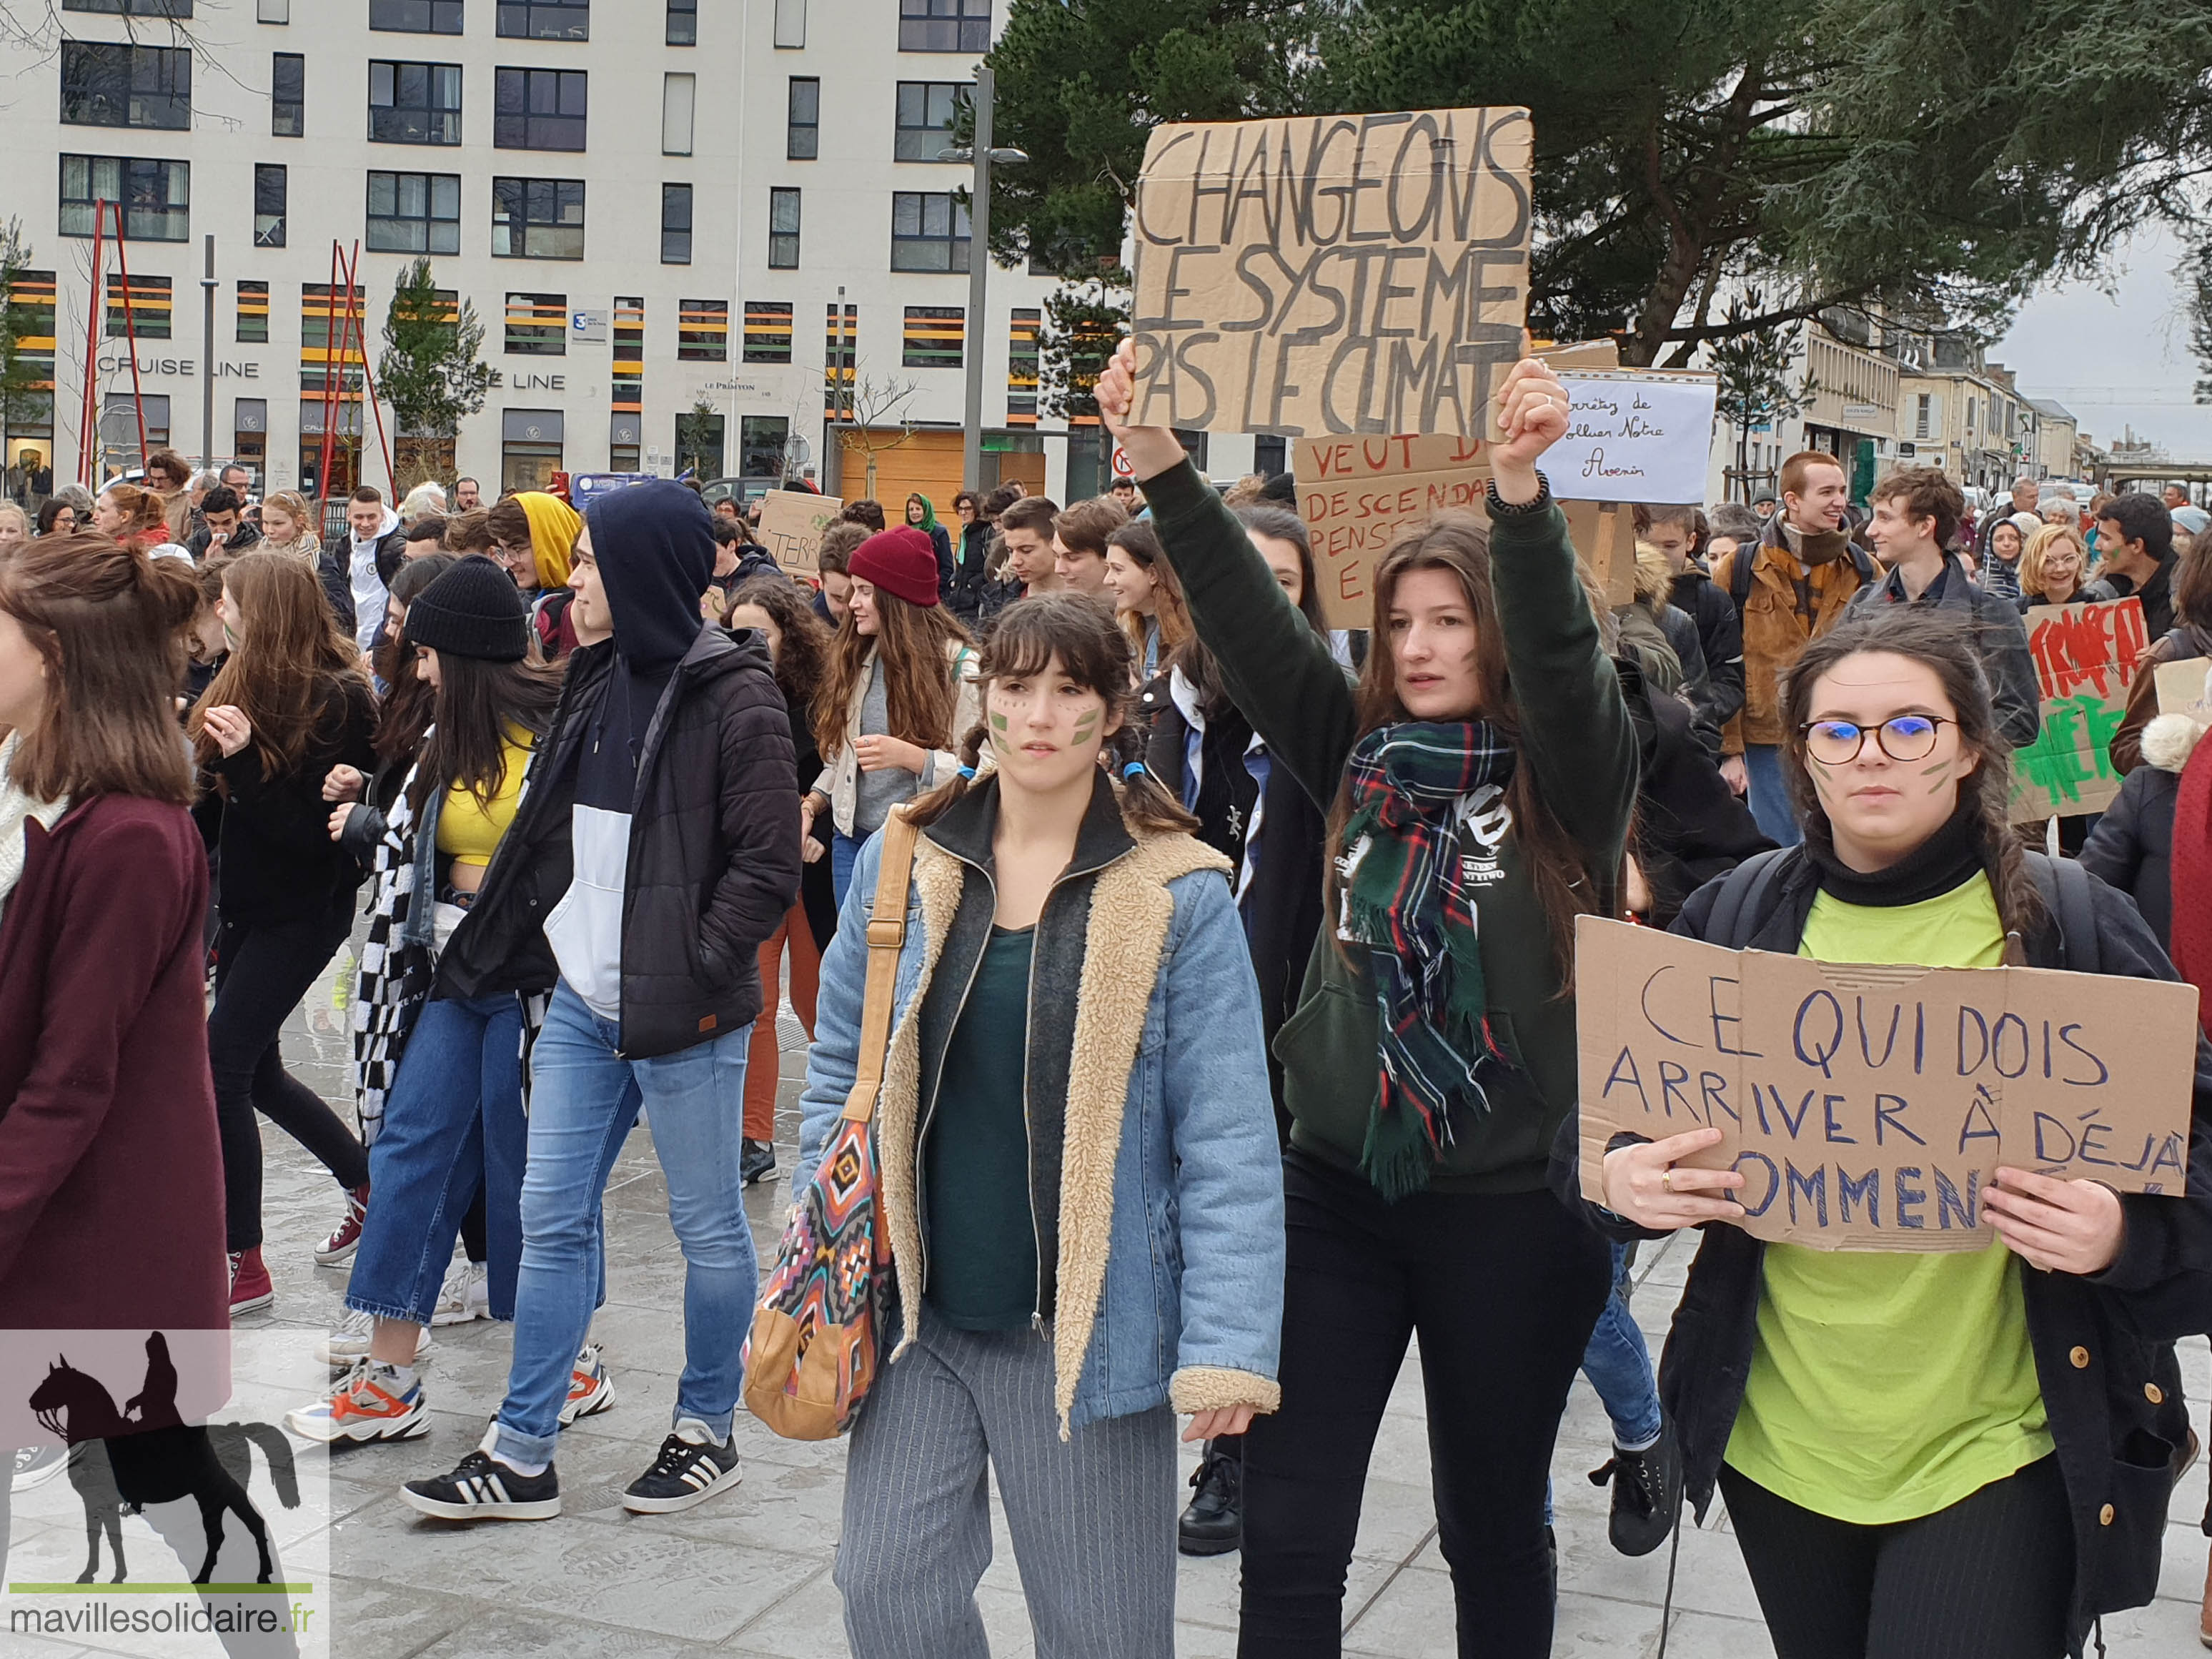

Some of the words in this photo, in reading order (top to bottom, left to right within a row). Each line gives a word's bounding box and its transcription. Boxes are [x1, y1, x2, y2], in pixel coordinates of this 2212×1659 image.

[1138, 107, 1529, 248] CHANGEONS
[1133, 240, 1221, 331] LE
[1219, 244, 1525, 342] SYSTEME
[98, 357, 194, 375] CRUISE
[212, 361, 259, 378] INE
[514, 373, 565, 390] LINE
[1132, 332, 1219, 430] PAS
[1242, 331, 1320, 435] LE
[1321, 336, 1521, 439] CLIMAT
[1632, 392, 1652, 410] de
[1565, 420, 1612, 440] olluer
[1617, 416, 1665, 439] Notre
[1311, 434, 1419, 477] VEUT
[1449, 437, 1489, 462] D
[1582, 447, 1645, 477] Avenir
[1306, 478, 1489, 523] DESCENDA
[1641, 965, 1763, 1057] CE
[1792, 989, 1923, 1079] QUI
[1957, 1004, 2108, 1086] DOIS
[1602, 1045, 1927, 1146] ARRIVER
[1958, 1082, 2003, 1156] À
[2033, 1108, 2184, 1179] DÉJÀ
[1711, 1150, 1998, 1229] OMMEN
